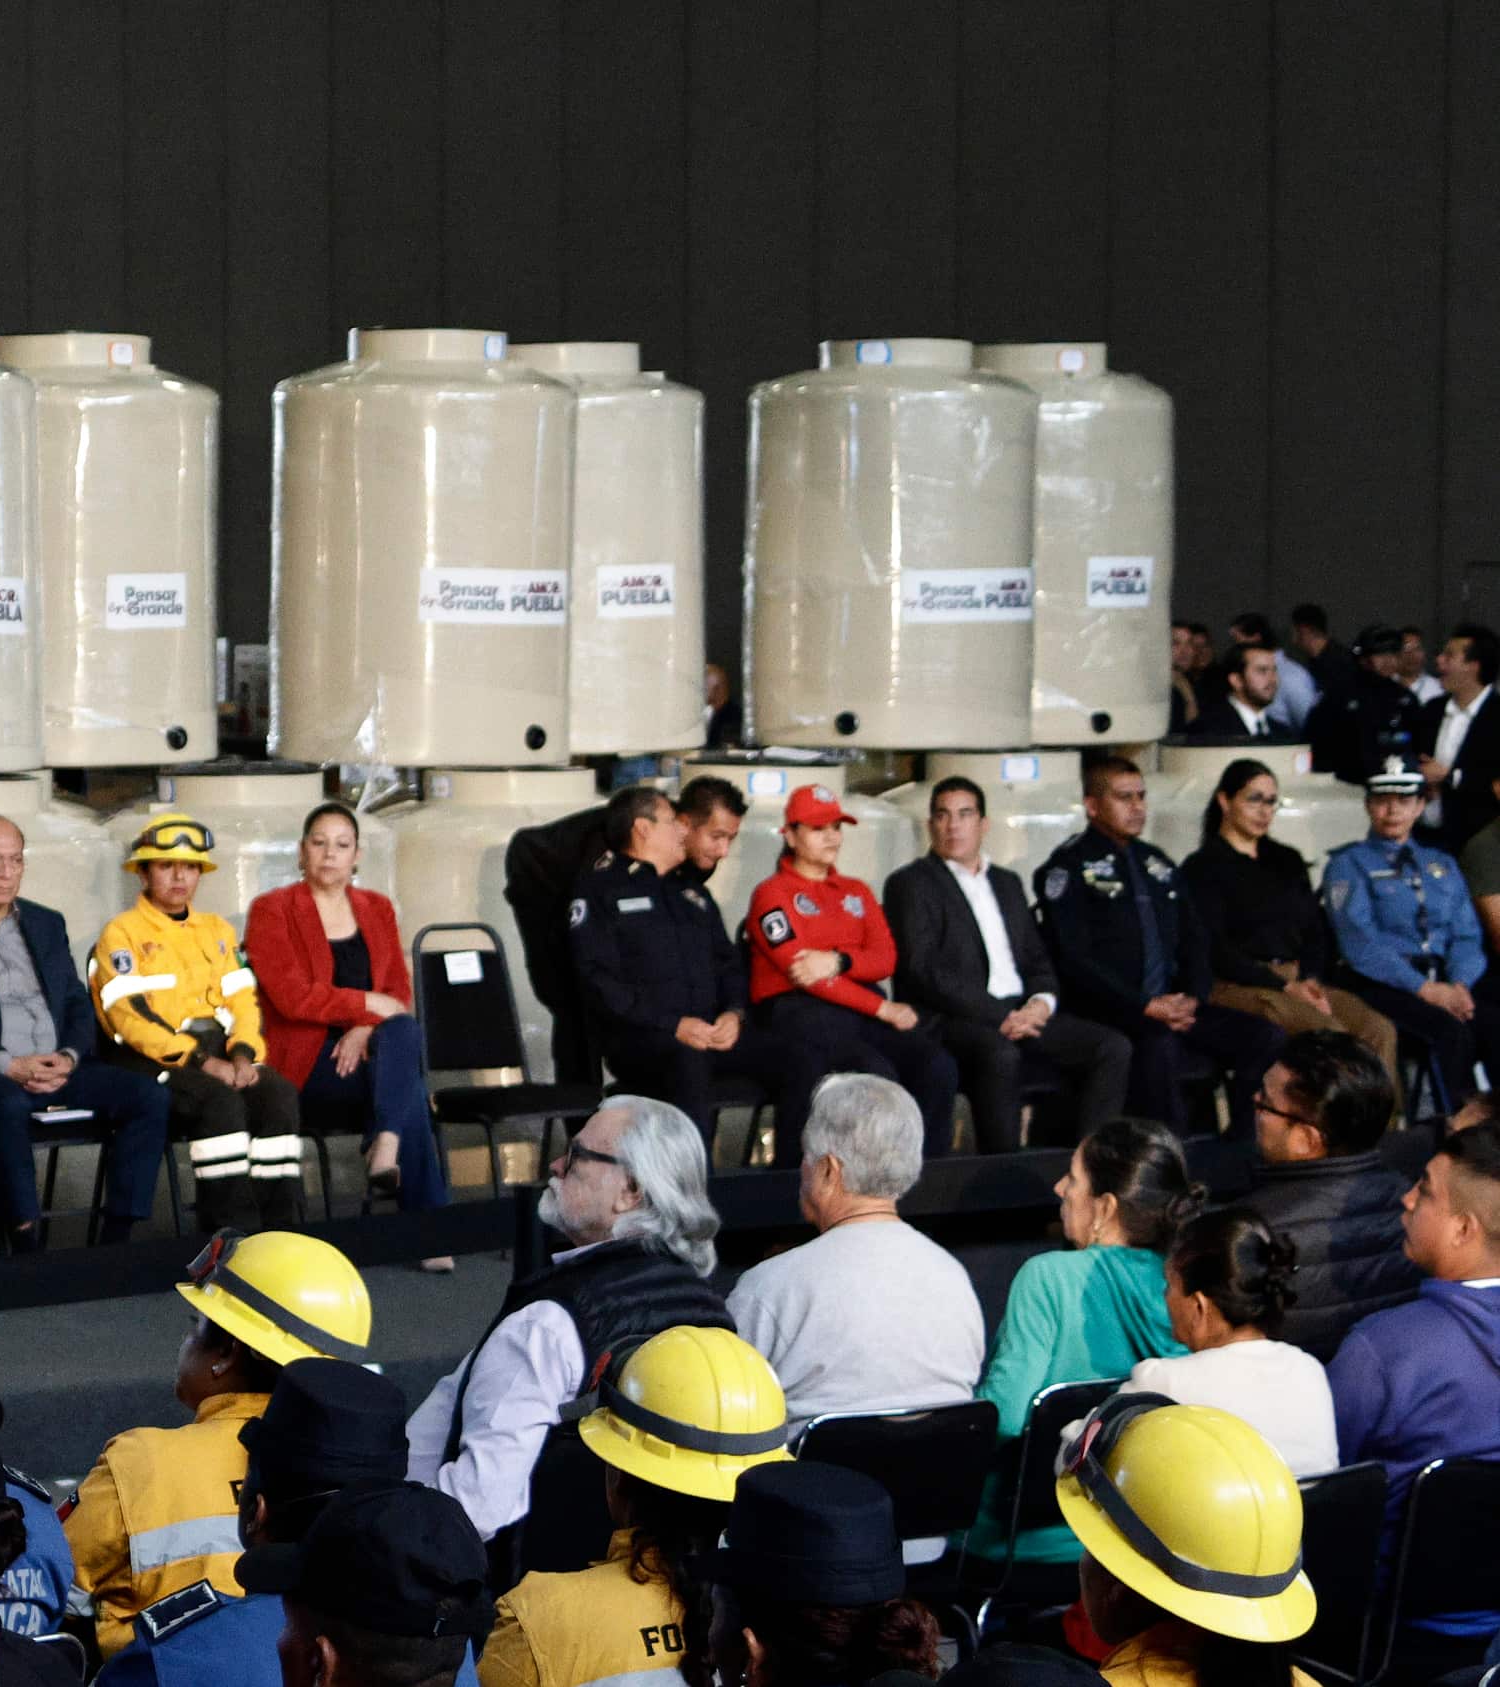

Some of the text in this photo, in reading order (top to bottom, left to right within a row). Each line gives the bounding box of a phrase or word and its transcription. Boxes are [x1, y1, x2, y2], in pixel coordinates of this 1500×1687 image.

[124, 585, 178, 602] Pensar
[439, 580, 499, 597] Pensar
[1091, 579, 1147, 596] PUEBLA
[510, 595, 565, 612] PUEBLA
[601, 588, 672, 606] PUEBLA
